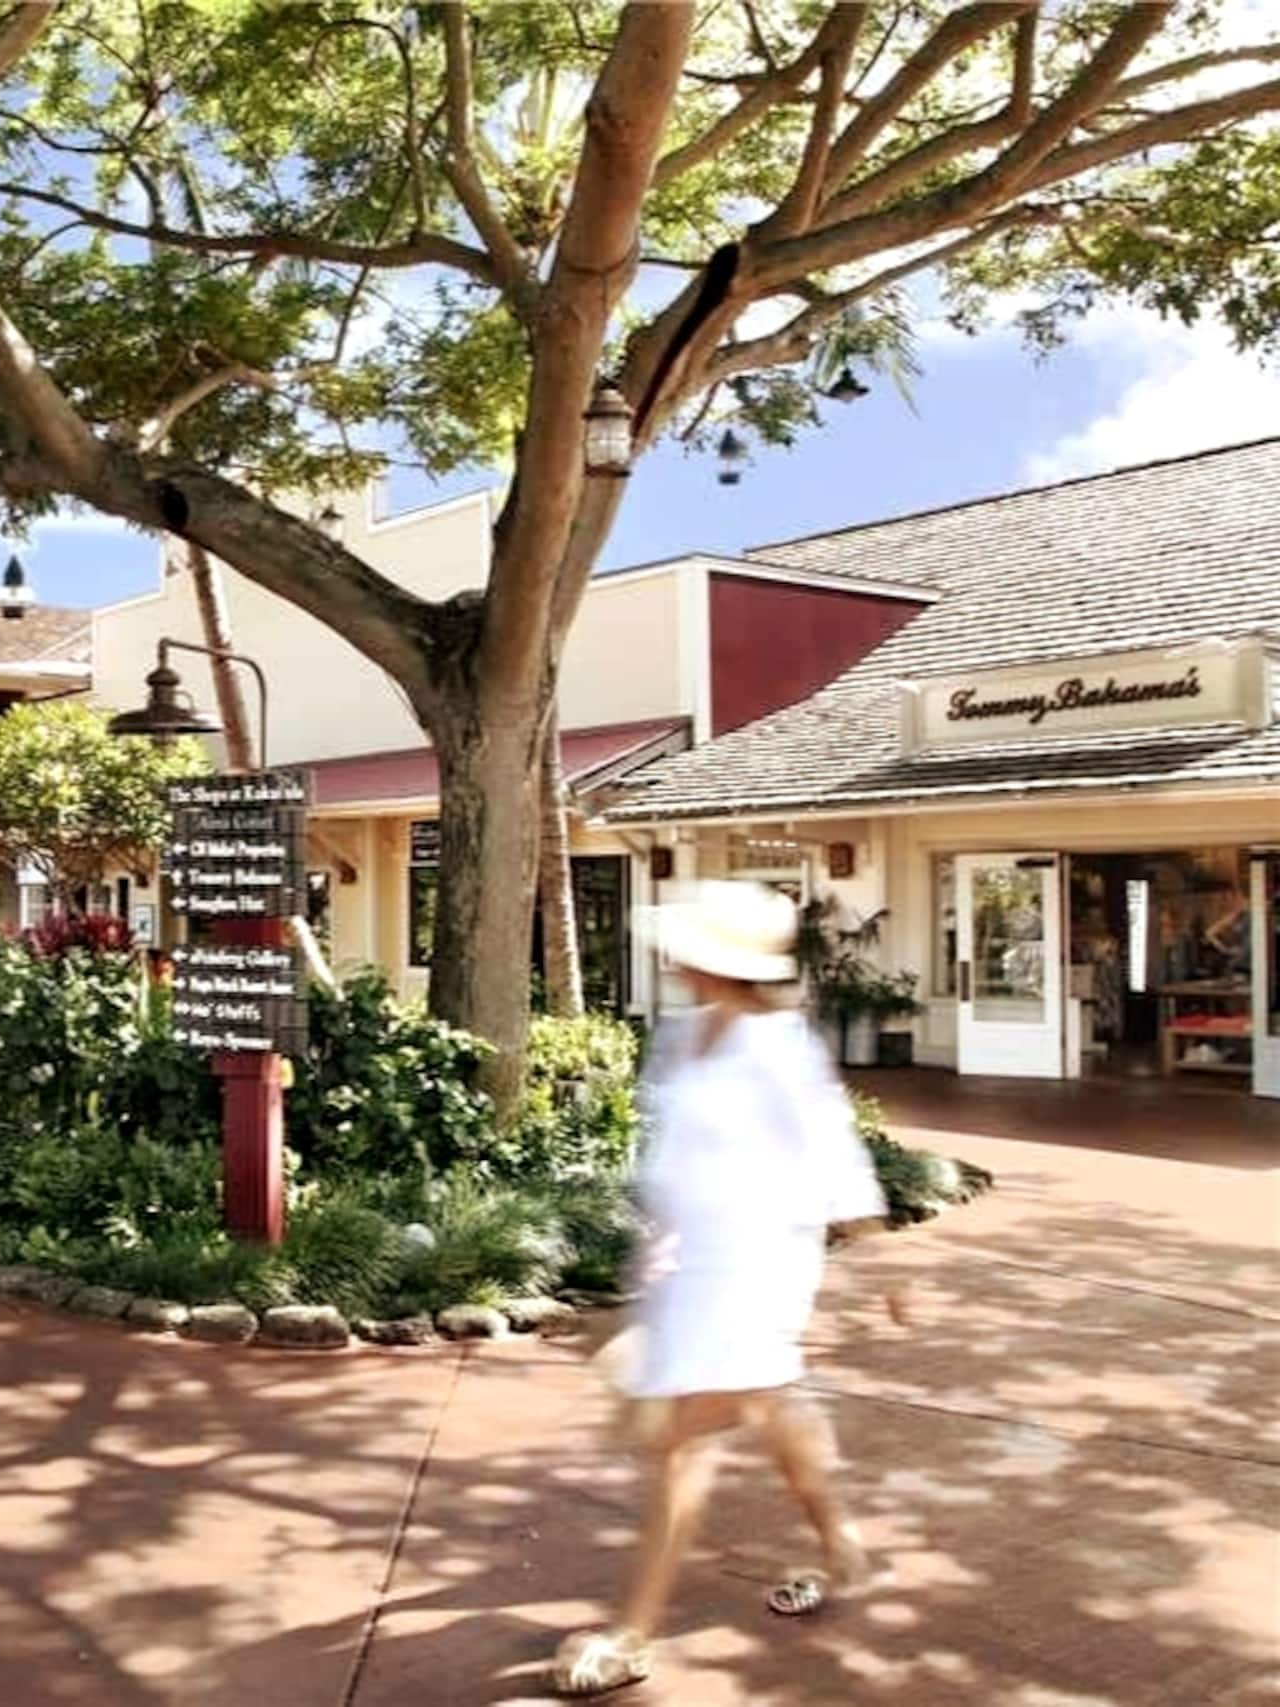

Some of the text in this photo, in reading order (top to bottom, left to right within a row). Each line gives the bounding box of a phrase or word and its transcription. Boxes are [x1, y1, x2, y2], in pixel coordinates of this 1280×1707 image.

[947, 688, 1046, 723] Tommy
[192, 786, 227, 806] Shops
[188, 868, 232, 887] Tommy
[246, 950, 291, 969] Gallery
